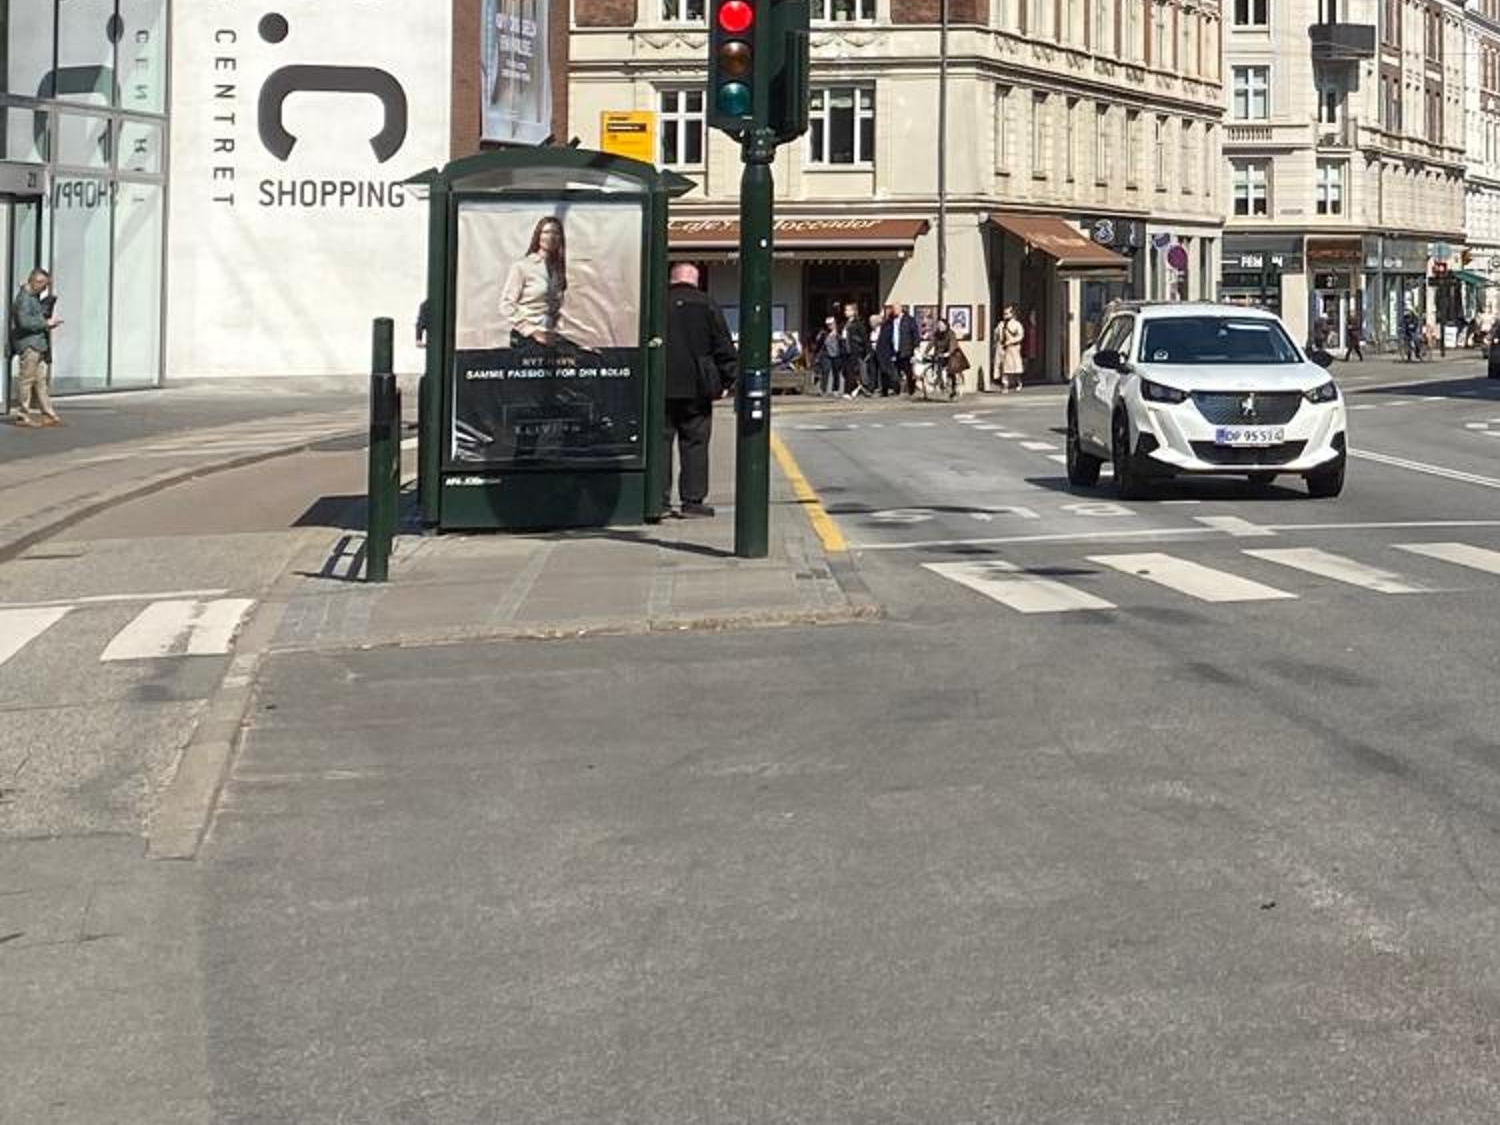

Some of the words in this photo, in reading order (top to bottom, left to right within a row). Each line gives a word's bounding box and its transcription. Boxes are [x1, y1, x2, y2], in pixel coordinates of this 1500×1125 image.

[212, 28, 238, 206] CENTRET
[258, 180, 406, 208] SHOPPING
[466, 370, 504, 380] SAMME
[556, 369, 576, 378] FOR
